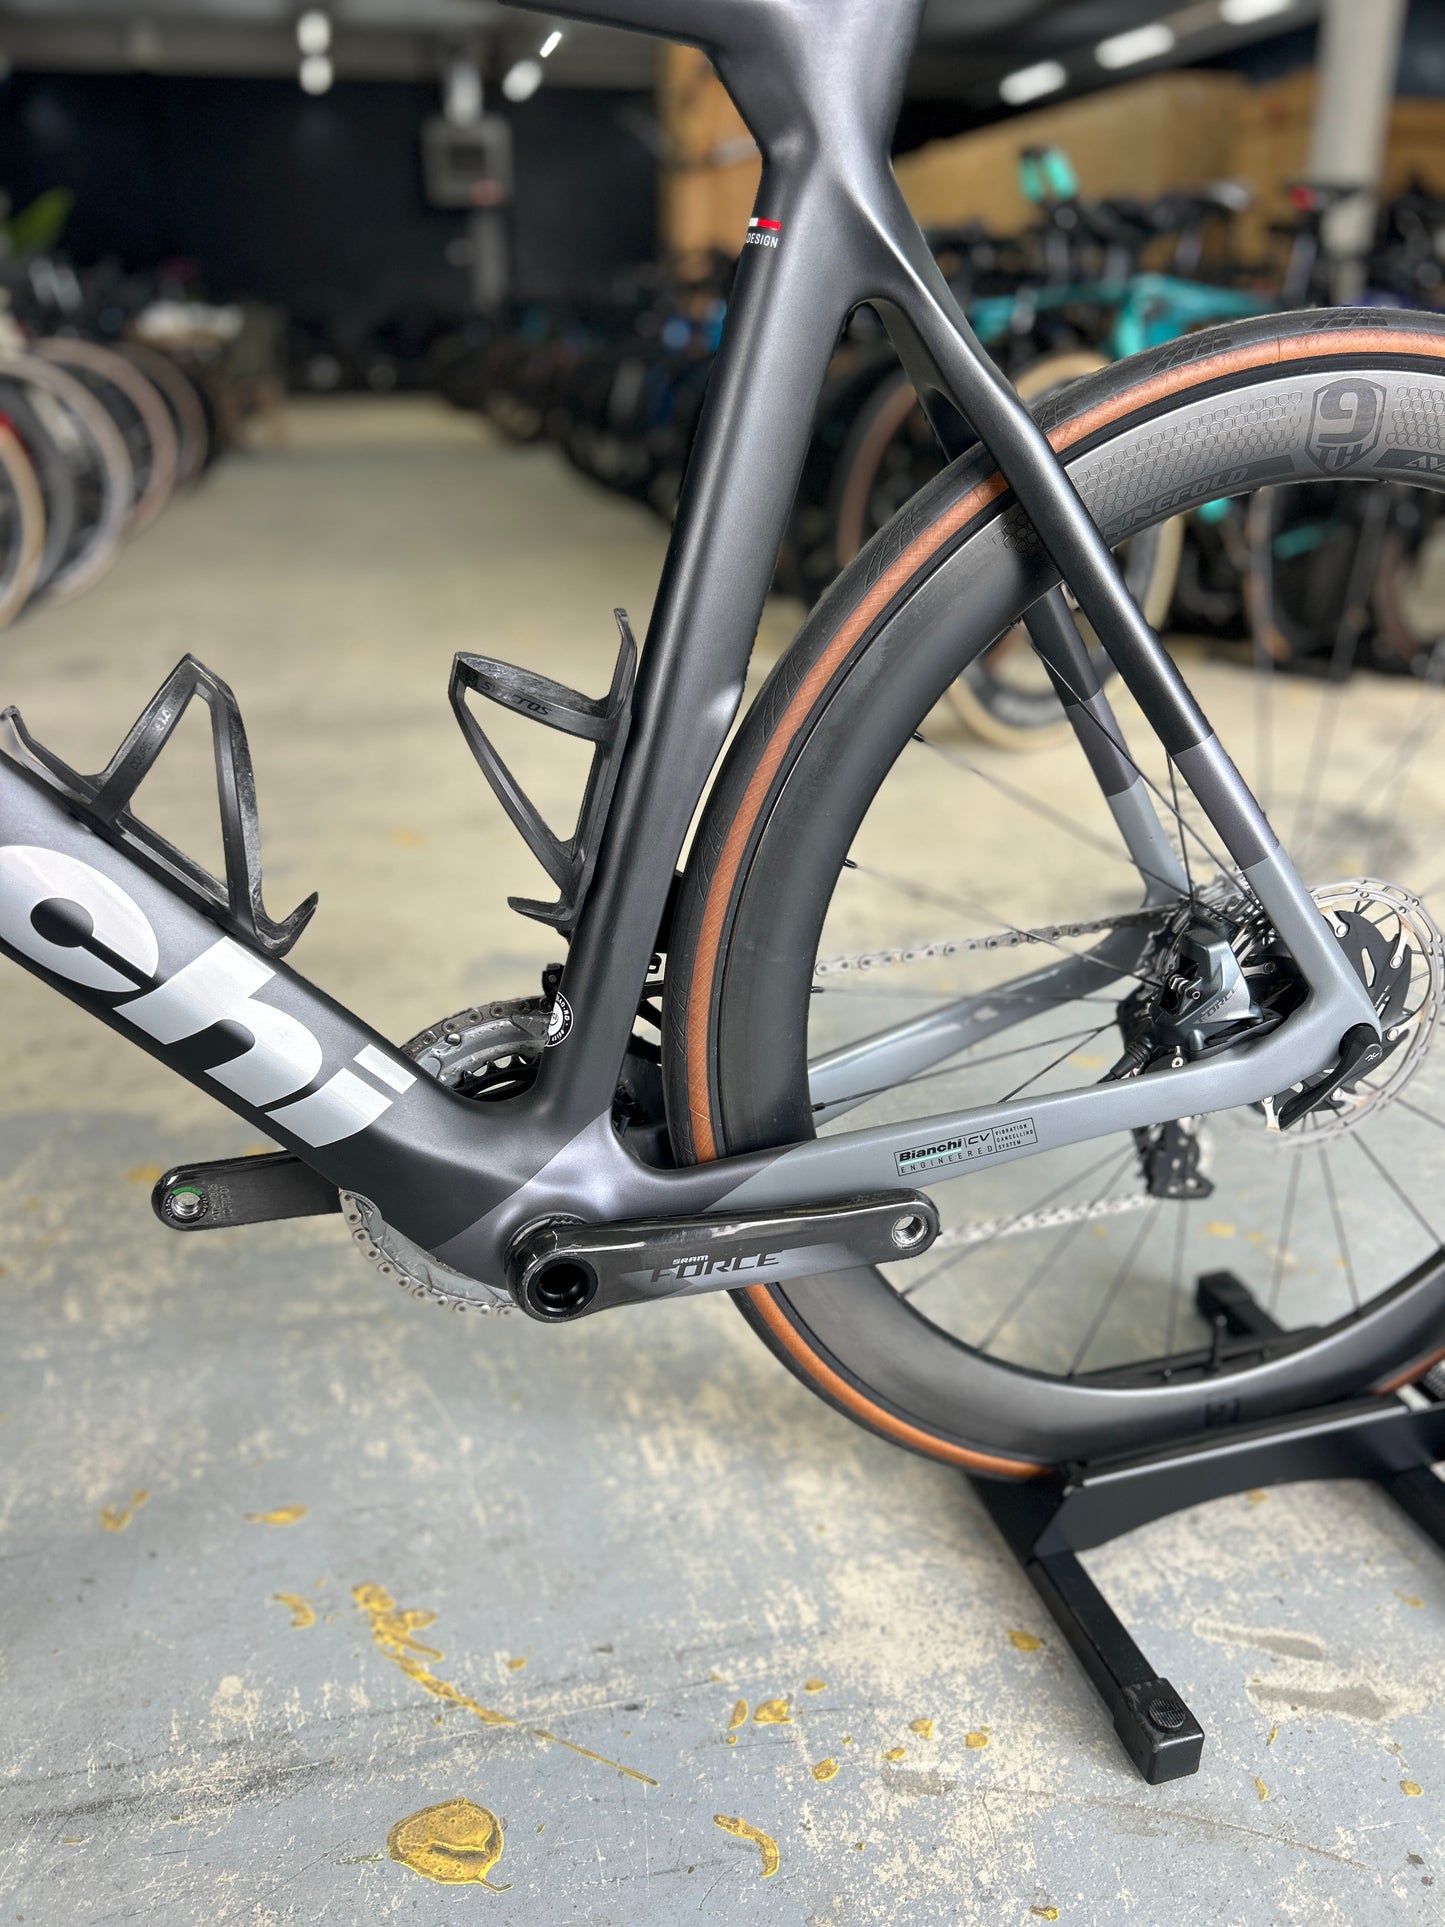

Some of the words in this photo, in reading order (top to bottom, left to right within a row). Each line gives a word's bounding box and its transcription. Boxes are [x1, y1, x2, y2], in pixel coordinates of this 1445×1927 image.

[746, 233, 778, 249] DESIGN
[1316, 443, 1363, 469] TH
[1102, 468, 1249, 538] NINEFOLD
[995, 1123, 1027, 1136] VIBRATION
[996, 1129, 1034, 1143] CANCELLING
[900, 1138, 962, 1162] Bianchi
[968, 1132, 990, 1145] CV
[998, 1139, 1021, 1150] SYSTEM
[901, 1145, 993, 1174] ENGINEERED
[650, 1252, 780, 1283] FORCE
[672, 1254, 709, 1266] SRAM
